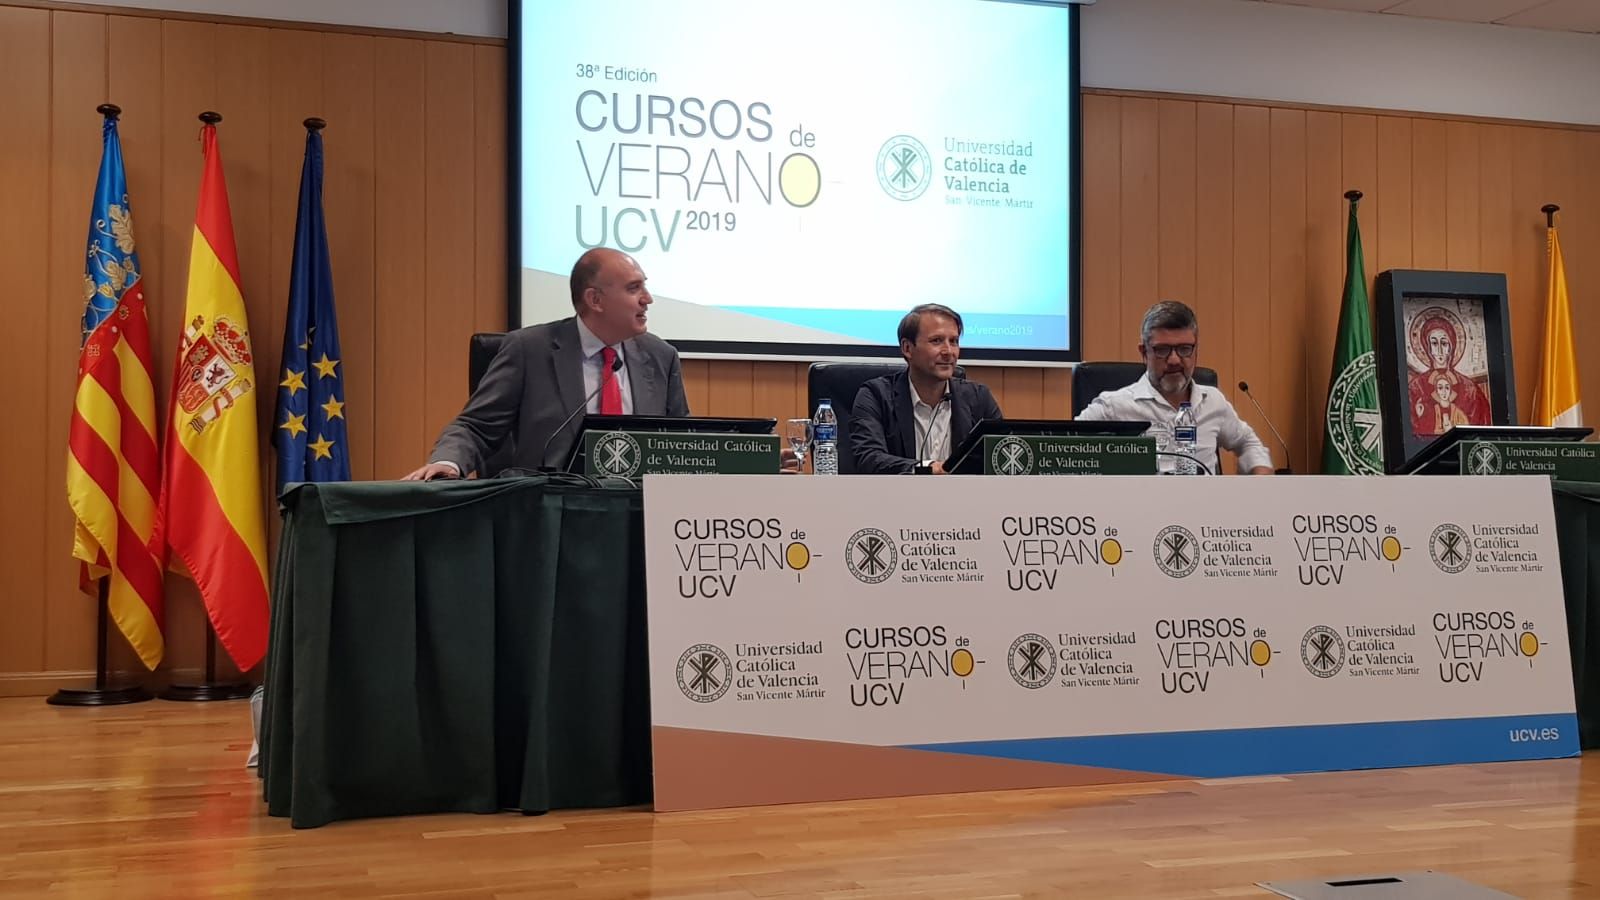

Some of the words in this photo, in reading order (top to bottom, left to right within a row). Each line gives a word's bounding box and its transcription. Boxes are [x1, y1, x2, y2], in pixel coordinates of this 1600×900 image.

[576, 63, 600, 78] 38ª
[605, 66, 657, 83] Edición
[575, 89, 773, 143] CURSOS
[789, 124, 816, 148] de
[944, 137, 1033, 157] Universidad
[576, 140, 821, 208] VERANO
[944, 157, 1005, 175] Católica
[1009, 160, 1027, 176] de
[944, 175, 1010, 193] Valencia
[967, 196, 1001, 207] Vicente
[575, 204, 682, 253] UCV
[686, 210, 737, 232] 2019
[647, 438, 719, 451] Universidad
[724, 439, 772, 453] Católica
[1038, 442, 1102, 454] Universidad
[1106, 442, 1148, 455] Católica
[1506, 447, 1558, 458] Universidad
[1561, 448, 1596, 458] Católica
[647, 453, 662, 465] de
[667, 454, 717, 467] Valencia
[1038, 456, 1052, 468] de
[1055, 456, 1100, 469] Valencia
[1506, 461, 1518, 470] de
[1520, 462, 1556, 471] Valencia
[674, 518, 782, 540] CURSOS
[790, 528, 806, 540] de
[1001, 516, 1097, 536] CURSOS
[1104, 526, 1118, 537] de
[1292, 514, 1378, 534] CURSOS
[1384, 524, 1397, 535] de
[1472, 523, 1539, 537] Universidad
[900, 528, 981, 542] Universidad
[1201, 526, 1274, 539] Universidad
[900, 542, 956, 556] Católica
[1202, 540, 1252, 553] Católica
[1294, 535, 1402, 562] VERANO
[1473, 537, 1520, 550] Católica
[675, 541, 810, 572] VERANO
[1003, 538, 1123, 566] VERANO
[1475, 551, 1489, 563] de
[1490, 550, 1538, 562] Valencia
[901, 558, 917, 571] de
[920, 557, 978, 571] Valencia
[1203, 555, 1218, 567] de
[1220, 554, 1272, 567] Valencia
[1204, 568, 1219, 578] San
[1220, 568, 1251, 578] Vicente
[1298, 564, 1344, 586] UCV
[1475, 564, 1490, 573] San
[1490, 564, 1519, 573] Vicente
[901, 573, 918, 583] San
[919, 573, 954, 583] Vicente
[1007, 569, 1057, 591] UCV
[678, 574, 737, 599] UCV
[1155, 617, 1246, 640] CURSOS
[1253, 627, 1267, 638] de
[1433, 611, 1515, 632] CURSOS
[1522, 620, 1534, 631] de
[845, 625, 947, 650] CURSOS
[955, 635, 970, 647] de
[1059, 632, 1136, 647] Universidad
[1346, 625, 1416, 639] Universidad
[735, 641, 823, 658] Universidad
[1347, 638, 1395, 652] Católica
[1434, 631, 1539, 660] VERANO
[1059, 647, 1112, 662] Católica
[1157, 639, 1271, 670] VERANO
[1348, 653, 1363, 666] de
[1365, 652, 1414, 666] Valencia
[736, 658, 796, 673] Católica
[846, 648, 974, 680] VERANO
[1060, 664, 1076, 676] de
[1079, 662, 1133, 676] Valencia
[1349, 667, 1364, 677] San
[1364, 667, 1395, 677] Vicente
[1439, 662, 1483, 684] UCV
[736, 674, 754, 688] de
[757, 673, 819, 688] Valencia
[1061, 678, 1077, 688] San
[1078, 676, 1112, 687] Vicente
[1161, 671, 1209, 694] UCV
[736, 691, 755, 702] San
[756, 689, 794, 701] Vicente
[850, 682, 905, 707] UCV
[1509, 726, 1560, 742] ucv.es
